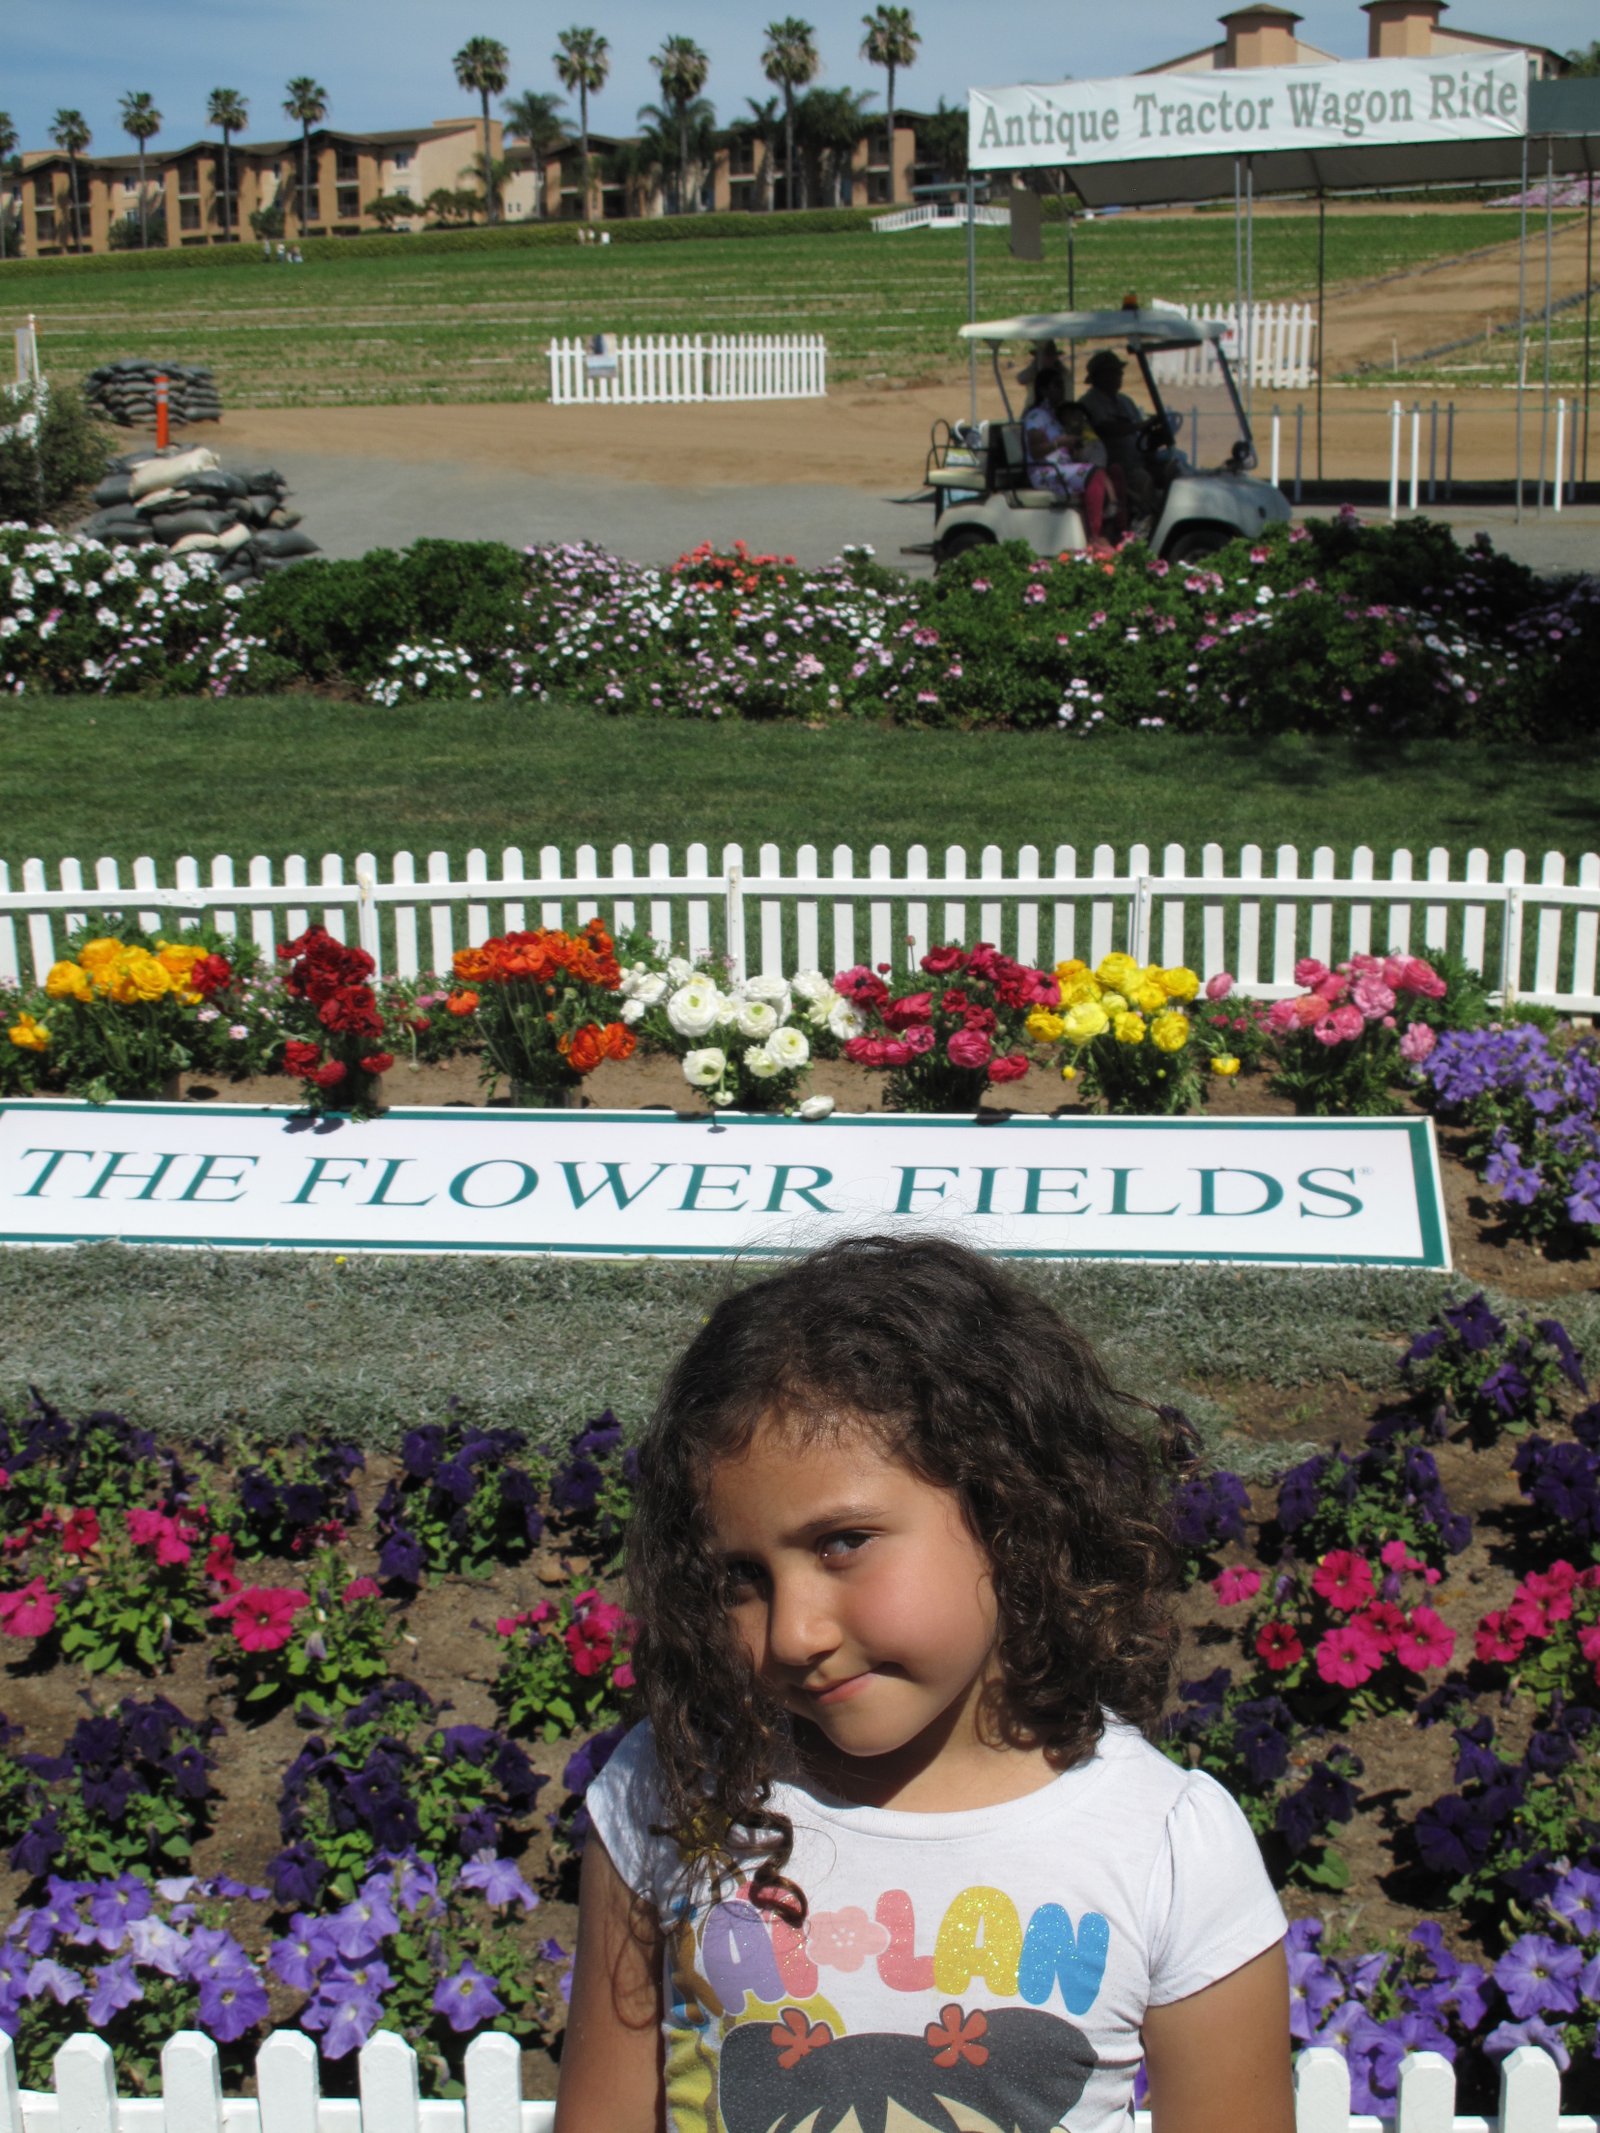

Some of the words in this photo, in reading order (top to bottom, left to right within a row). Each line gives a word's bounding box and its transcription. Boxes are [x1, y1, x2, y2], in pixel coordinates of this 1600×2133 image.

[978, 102, 1119, 156] Antique
[1133, 93, 1275, 138] Tractor
[1287, 82, 1413, 138] Wagon
[1428, 70, 1518, 120] Ride
[13, 1148, 260, 1203] THE
[281, 1156, 845, 1218] FLOWER
[887, 1166, 1364, 1219] FIELDS
